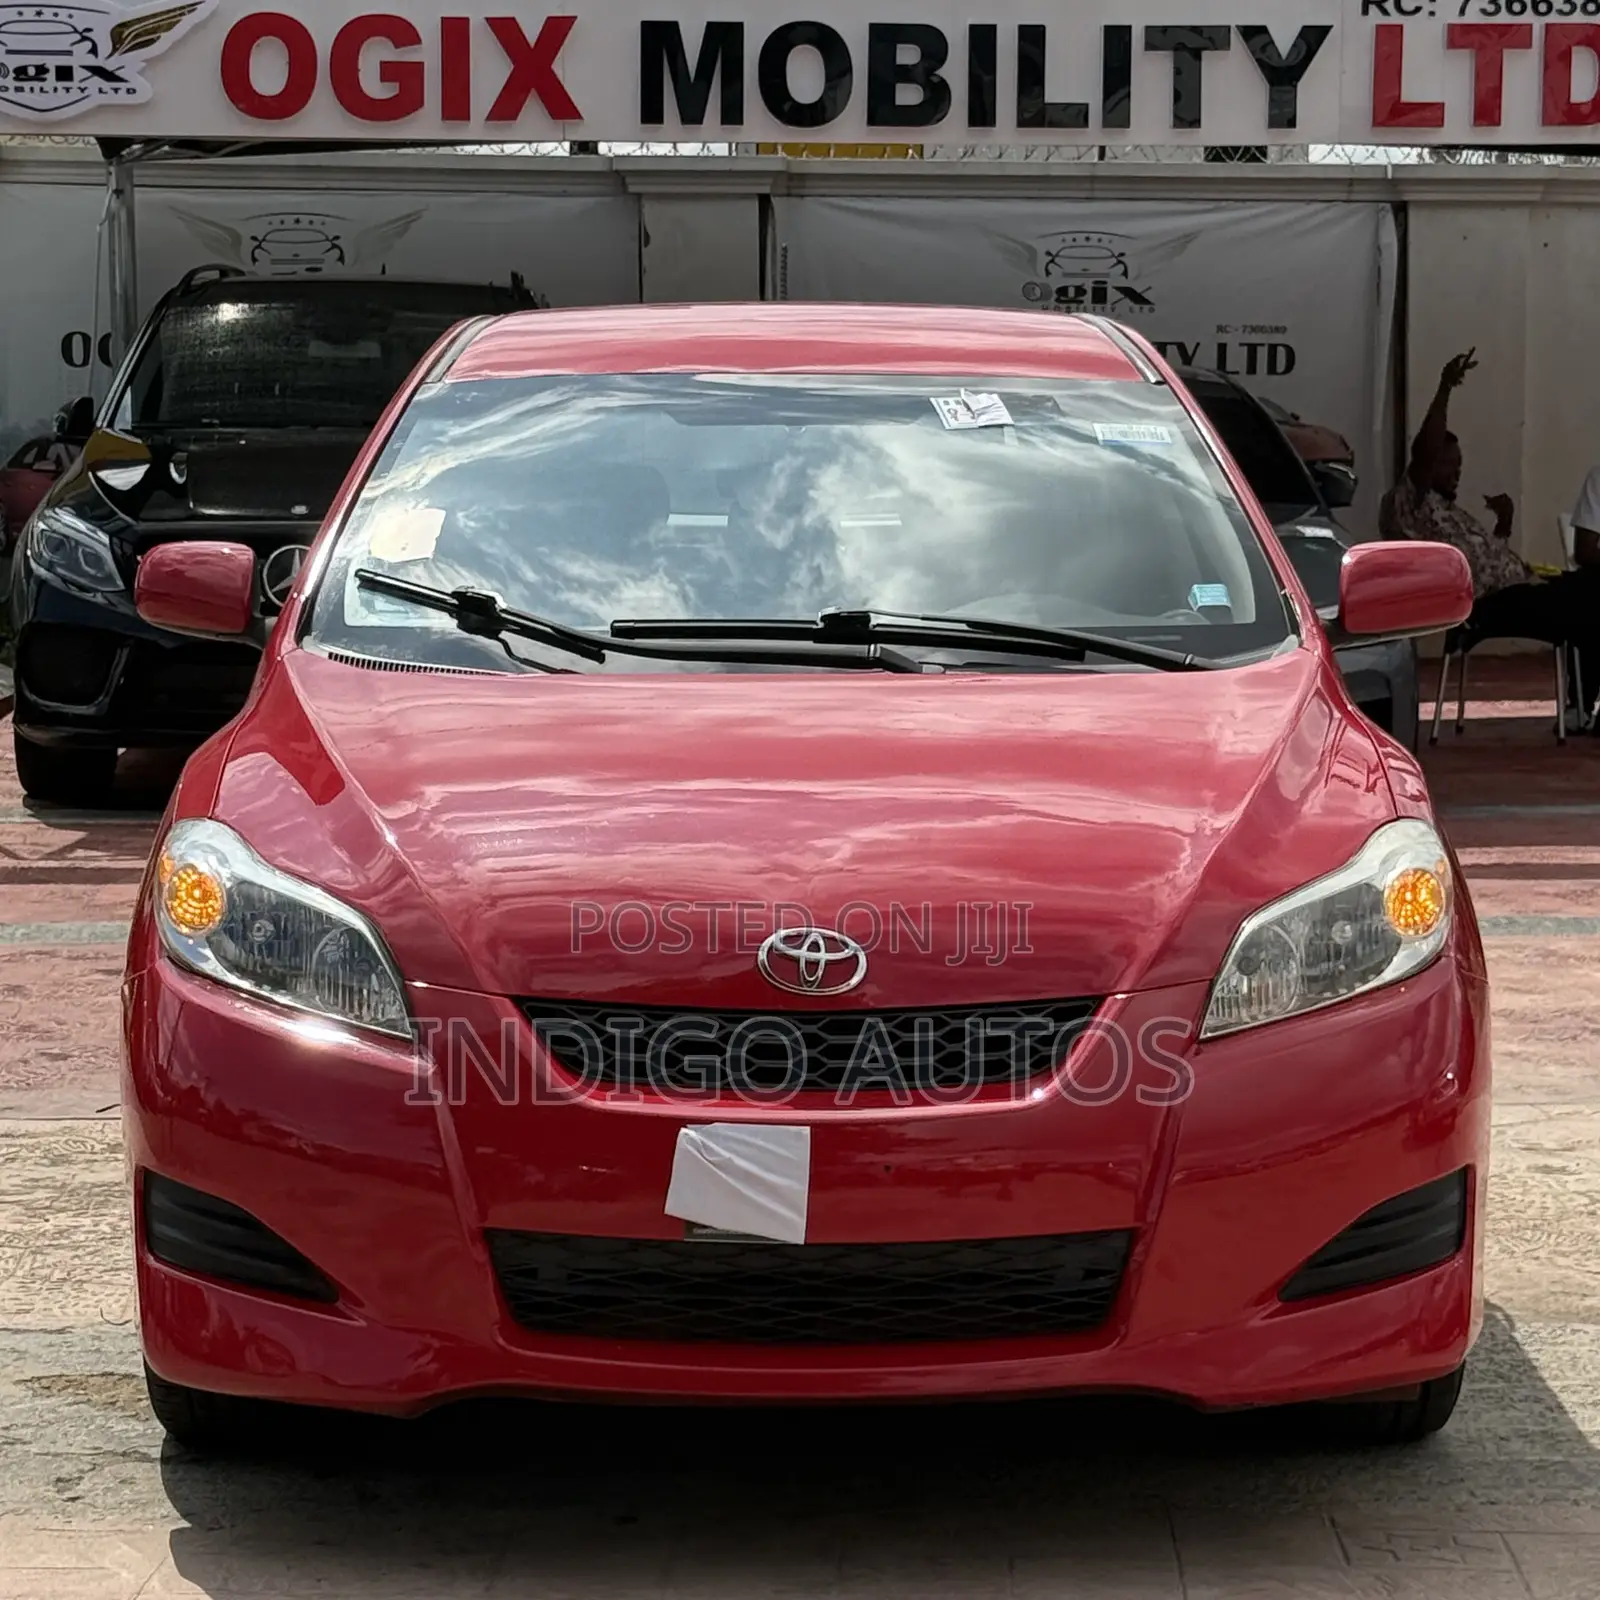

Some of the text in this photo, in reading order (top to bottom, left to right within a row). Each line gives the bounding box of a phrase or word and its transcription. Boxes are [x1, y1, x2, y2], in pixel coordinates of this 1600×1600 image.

[1361, 0, 1436, 17] RC:
[220, 11, 1600, 128] OGIX MOBILITY LTD
[0, 85, 137, 95] OBILITY LTD
[1151, 341, 1296, 376] TY LTD
